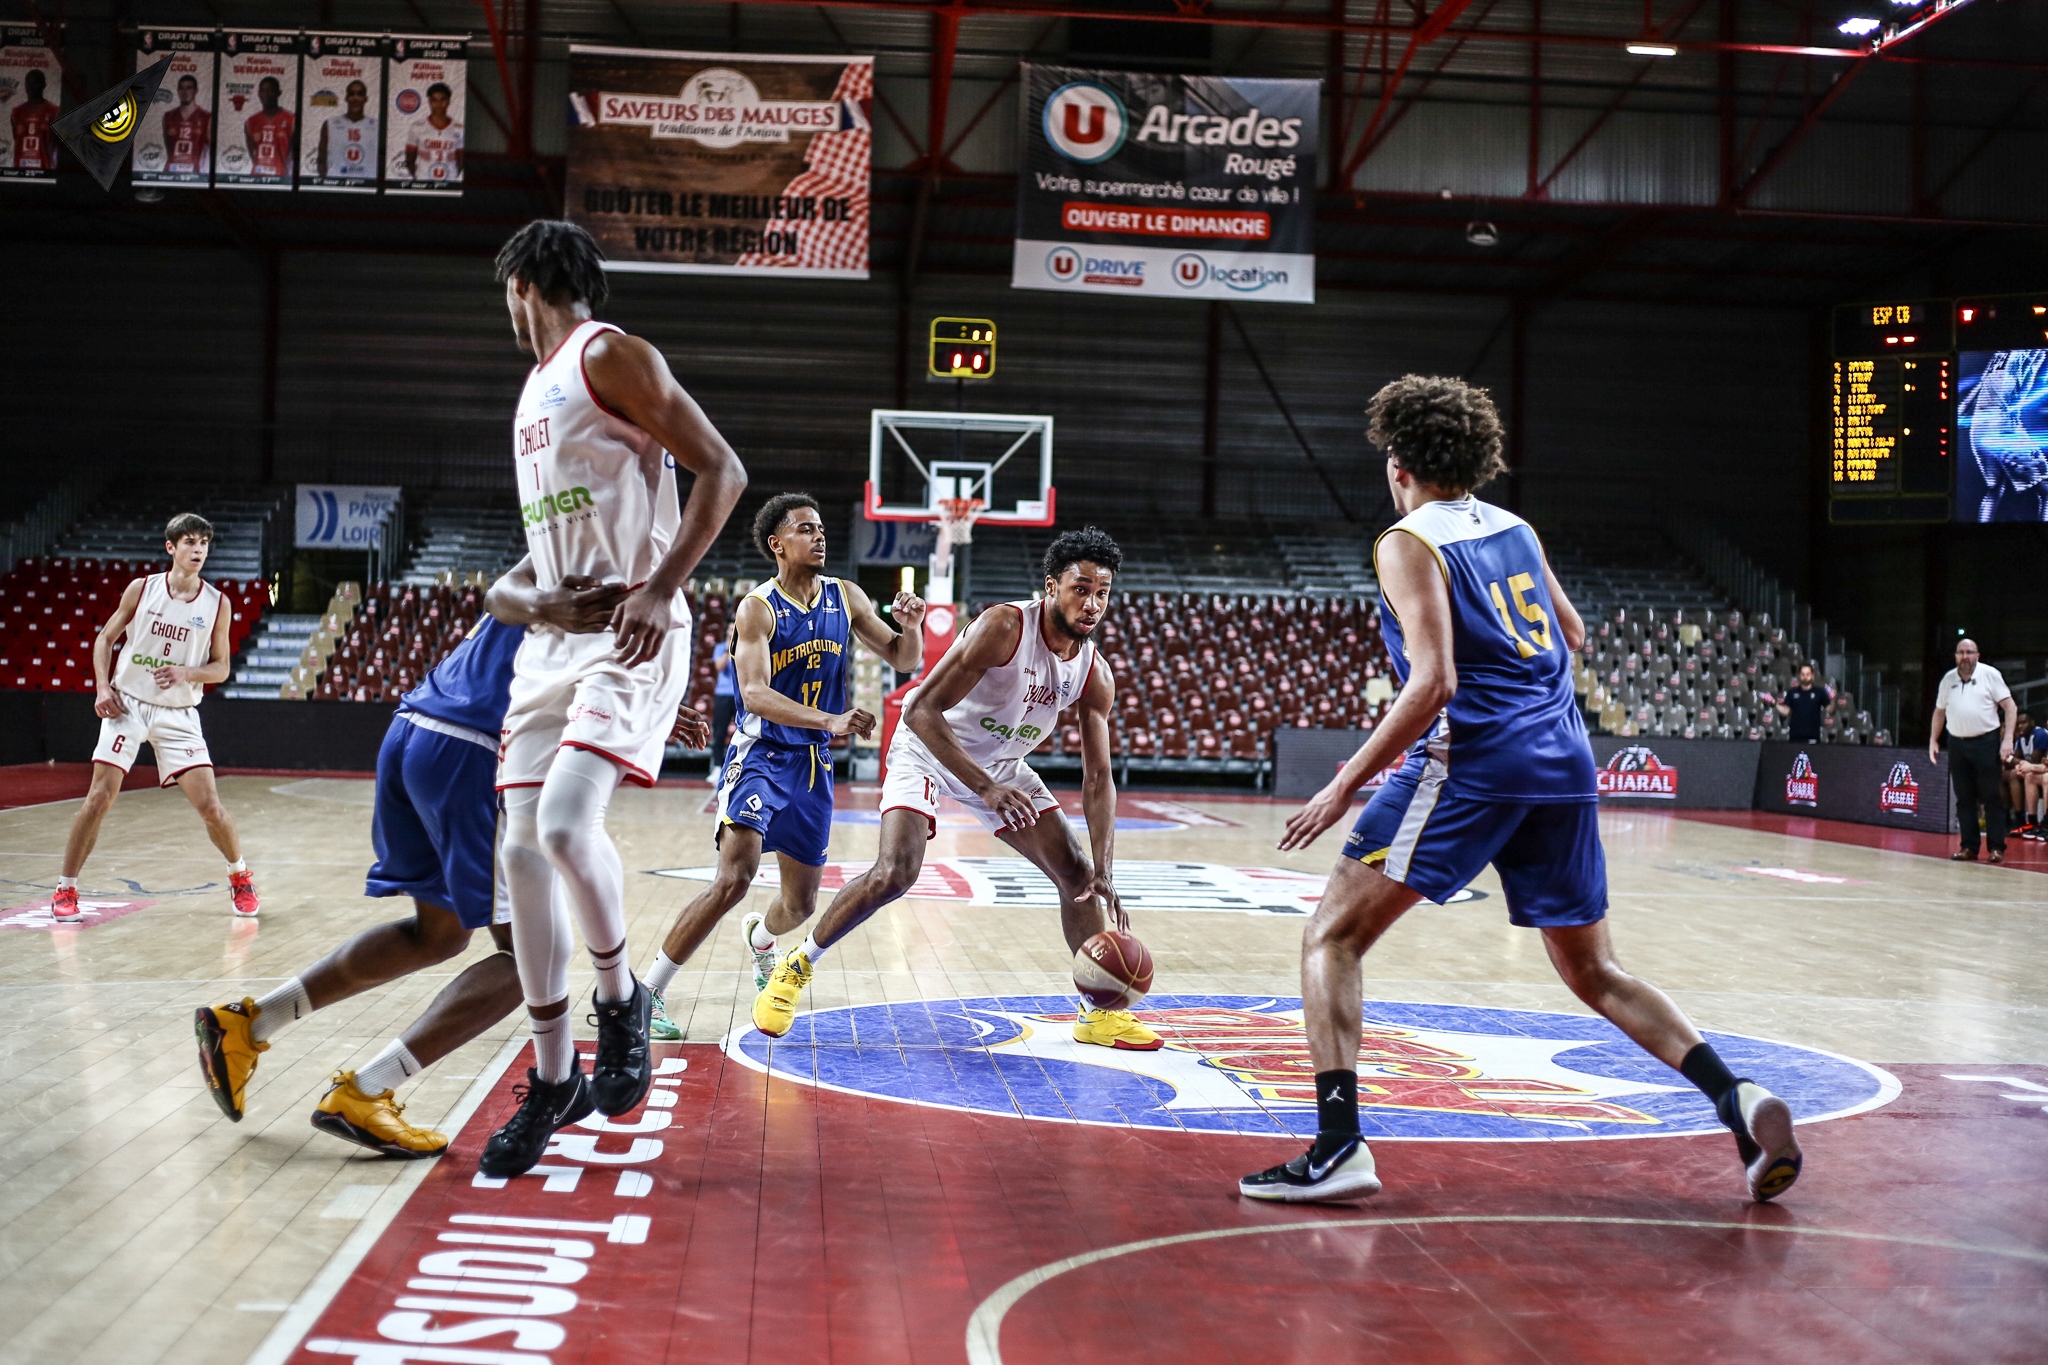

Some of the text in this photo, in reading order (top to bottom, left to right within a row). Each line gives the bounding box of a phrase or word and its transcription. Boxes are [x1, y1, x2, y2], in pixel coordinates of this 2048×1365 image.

[158, 32, 209, 42] DRAFT NBA
[605, 98, 834, 127] SAVEURS DES MAUGES
[1064, 103, 1106, 144] U
[1136, 104, 1302, 147] Arcades
[1224, 153, 1297, 181] Rougé
[1034, 171, 1081, 193] Votre
[1084, 179, 1185, 200] supermarché
[1236, 186, 1258, 203] de
[1261, 187, 1289, 205] ville
[680, 192, 700, 216] LE
[709, 194, 816, 220] MEILLEUR
[823, 197, 851, 222] DE
[1067, 210, 1266, 236] OUVERT LE DIMANCHE
[635, 226, 708, 251] VOTRE
[1084, 257, 1147, 277] DRIVE
[1210, 258, 1289, 285] location
[519, 417, 550, 457] CHOLET
[1489, 572, 1554, 660] 15
[150, 620, 191, 643] CHOLET
[163, 642, 172, 657] 6
[801, 680, 823, 709] 17
[111, 734, 126, 754] 6
[1596, 773, 1674, 792] CHARAL
[1786, 778, 1816, 800] CHARAL
[228, 1002, 241, 1012] 23
